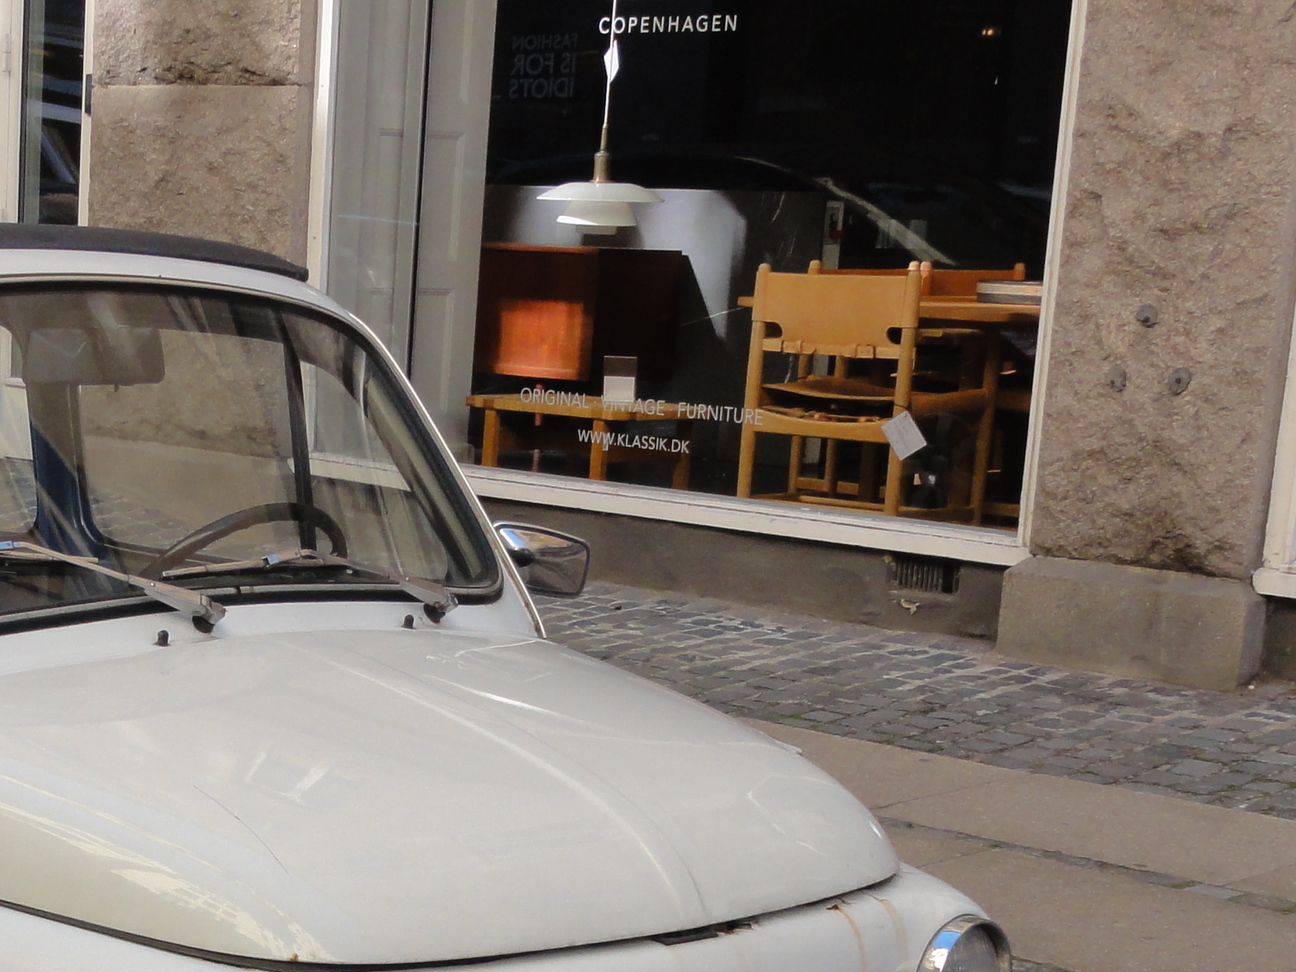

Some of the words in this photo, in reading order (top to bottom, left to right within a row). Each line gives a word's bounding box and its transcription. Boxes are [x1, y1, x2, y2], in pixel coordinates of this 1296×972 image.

[598, 14, 738, 35] COPENHAGEN
[520, 387, 590, 409] ORIGINAL
[677, 401, 764, 426] FURNITURE
[577, 428, 691, 454] WWW.KLASSIK.DK
